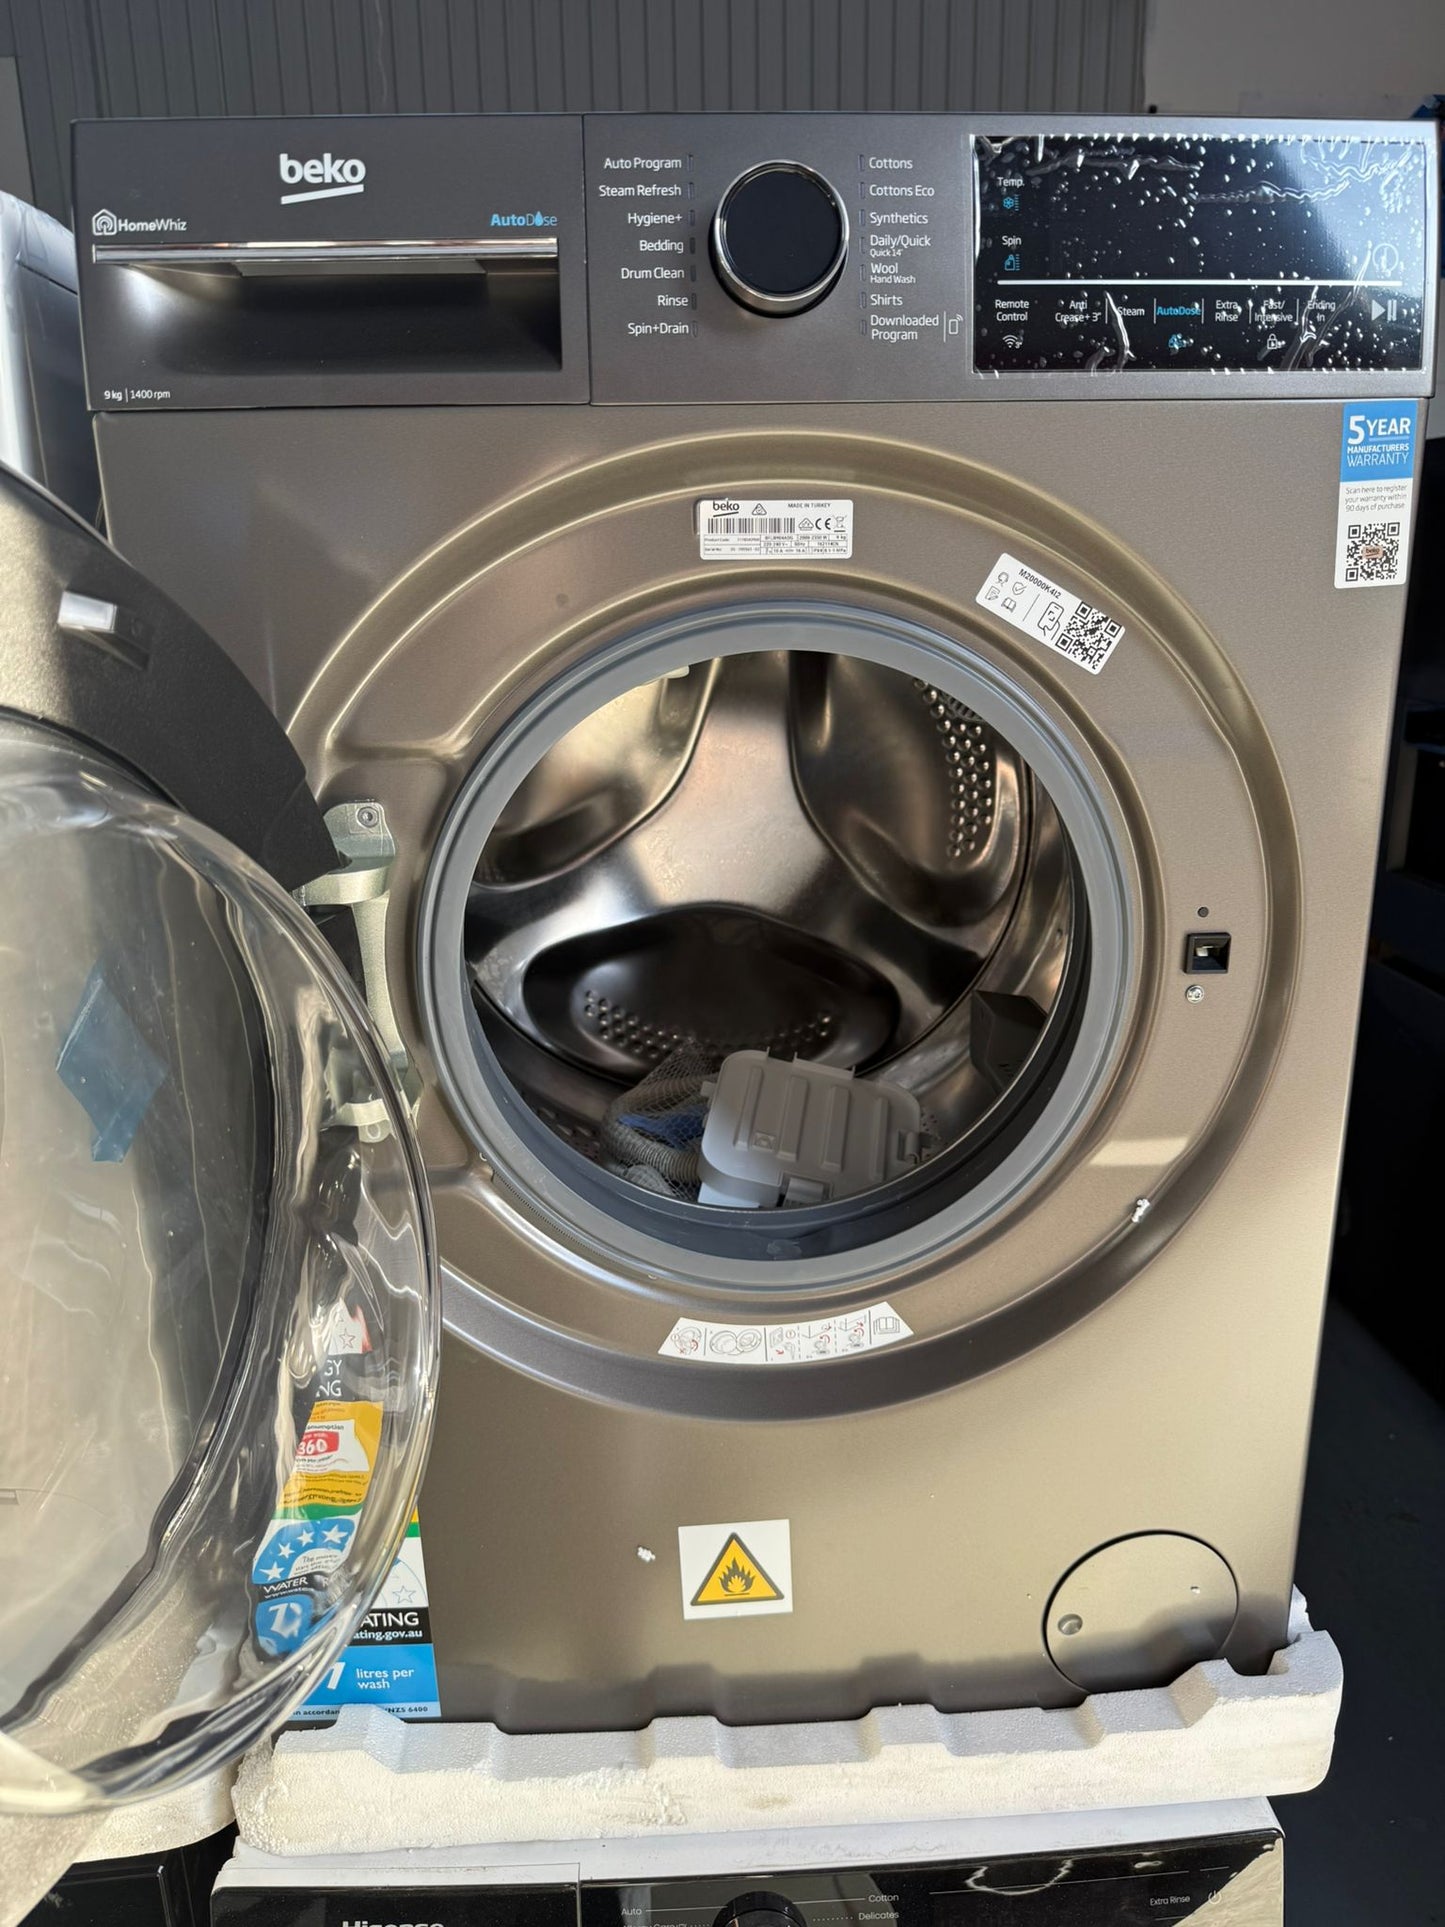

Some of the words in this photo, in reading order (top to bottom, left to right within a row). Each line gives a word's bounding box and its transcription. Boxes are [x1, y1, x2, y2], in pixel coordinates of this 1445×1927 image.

[279, 153, 367, 184] beko
[604, 157, 632, 169] Auto
[634, 157, 682, 172] Program
[869, 157, 913, 169] Cottons
[997, 176, 1025, 188] Temp.
[599, 185, 637, 196] Steam
[638, 184, 682, 196] Refresh
[869, 184, 914, 197] Cottons
[915, 185, 935, 197] Eco
[118, 218, 187, 232] HomeWhiz
[627, 212, 683, 226] Hygiene+
[870, 212, 929, 226] Synthetics
[639, 239, 684, 253] Bedding
[870, 234, 931, 249] Daily/Quick
[1001, 235, 1022, 246] Spin
[870, 248, 891, 258] Quick
[621, 267, 654, 279] Drum
[654, 266, 685, 279] Clean
[870, 262, 899, 274] Wool
[870, 275, 893, 284] Hand
[893, 275, 917, 284] Wash
[657, 294, 688, 306] Rinse
[870, 293, 903, 306] Shirts
[995, 299, 1030, 310] Remote
[1069, 300, 1088, 310] Anti
[1215, 299, 1238, 310] Extra
[1263, 300, 1286, 310] Fast/
[1117, 306, 1145, 317] Steam
[1157, 306, 1201, 316] AutoDose
[1307, 300, 1337, 312] Ending
[870, 314, 940, 327] Downloaded
[996, 311, 1029, 321] Control
[1215, 312, 1239, 323] Rinse
[1254, 312, 1294, 323] Intensive
[627, 322, 689, 336] Spin+Drain
[871, 328, 918, 343] Program
[130, 389, 153, 399] 1400
[153, 391, 171, 401] rpm
[1347, 415, 1366, 444] 5
[1366, 417, 1412, 437] YEAR
[1347, 442, 1410, 454] MANUFACTURERS
[1347, 452, 1410, 467] WARRANTY
[1383, 484, 1407, 493] register
[712, 500, 740, 511] beko
[1345, 497, 1359, 505] your
[1359, 495, 1386, 503] warranty
[1345, 504, 1355, 512] 90
[1355, 504, 1370, 512] days
[1378, 502, 1405, 511] purchase
[263, 1576, 308, 1594] WATER
[360, 1612, 419, 1627] ATING
[353, 1630, 423, 1641] ating.gov.au
[356, 1668, 389, 1679] litres
[392, 1669, 415, 1680] per
[357, 1679, 390, 1690] wash
[868, 1894, 900, 1903] Cotton
[1149, 1897, 1169, 1907] Extra
[1169, 1895, 1191, 1904] Rinse
[621, 1907, 643, 1916] Auto
[858, 1911, 900, 1921] Delicates
